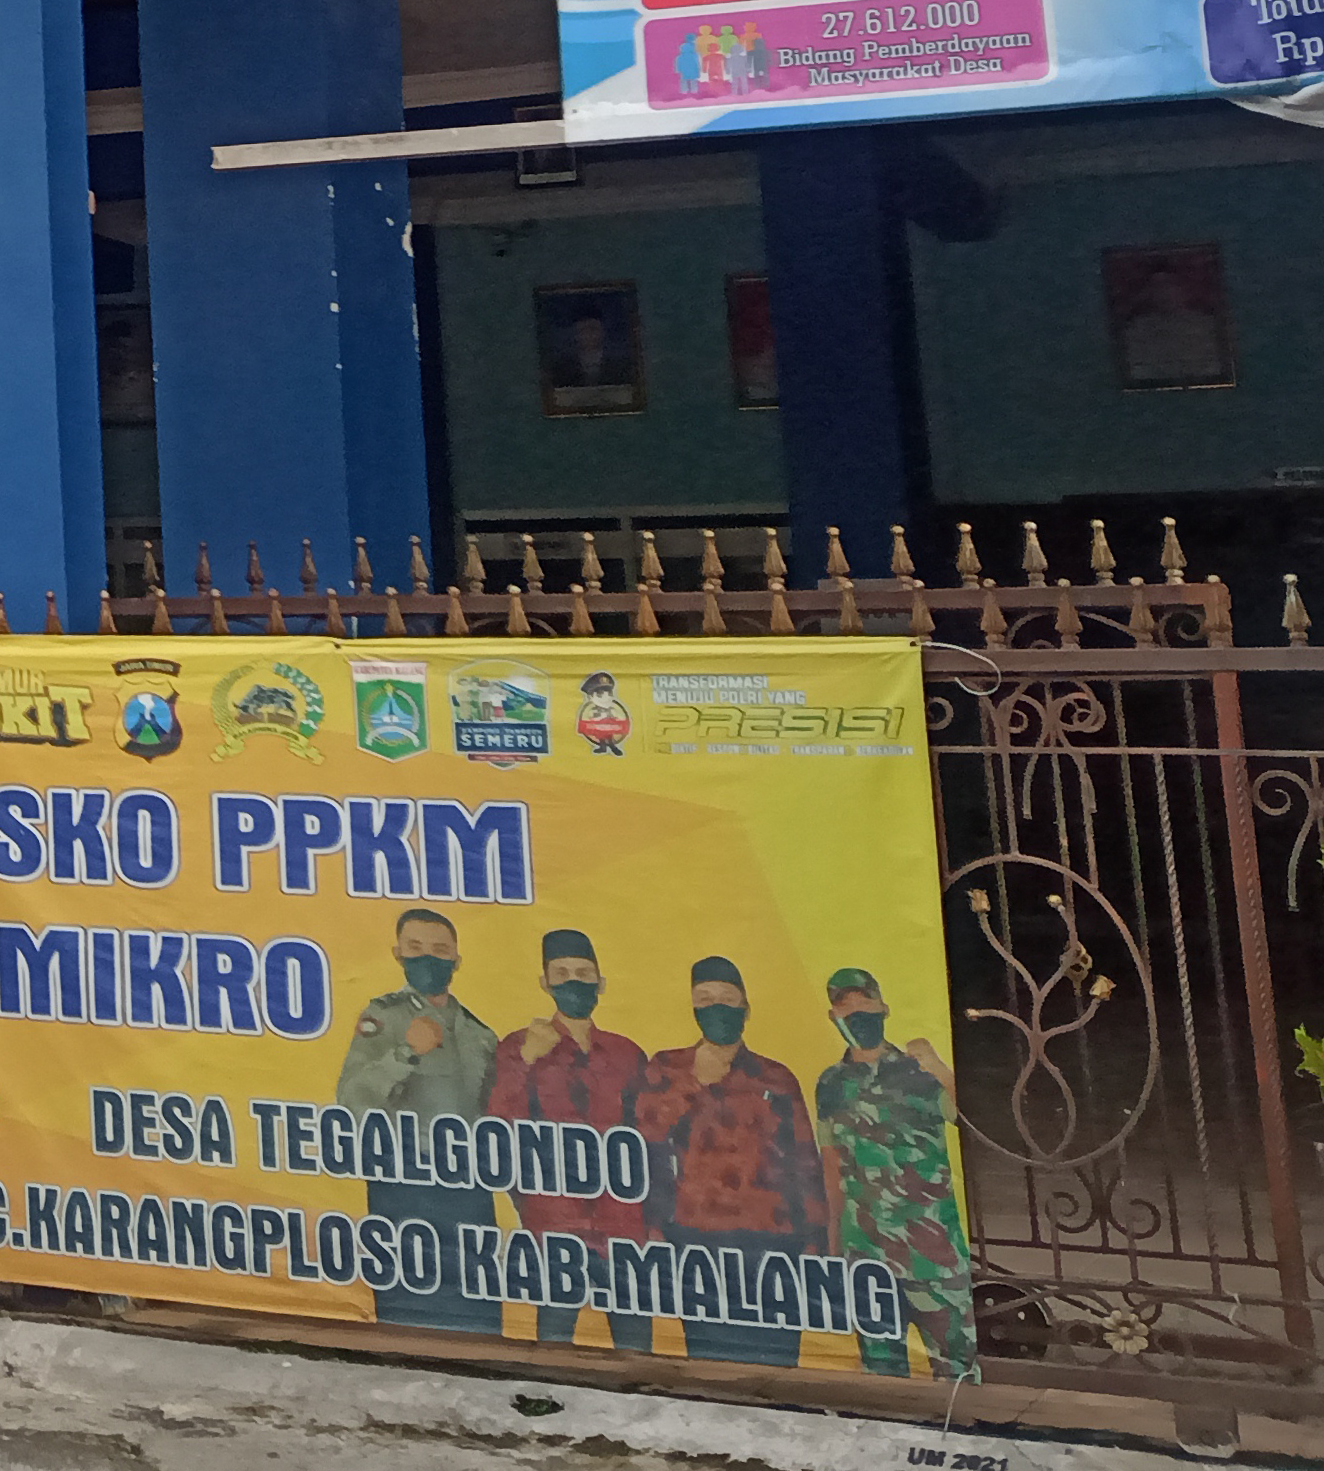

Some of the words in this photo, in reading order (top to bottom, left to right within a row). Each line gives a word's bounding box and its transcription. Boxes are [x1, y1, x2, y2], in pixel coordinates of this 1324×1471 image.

[821, 0, 980, 38] 27.612.000
[777, 47, 855, 68] Bidang
[862, 32, 1031, 61] Pemberdayaan
[809, 60, 941, 87] Masyarakat
[948, 57, 1002, 75] Desa
[652, 675, 769, 689] TRANSFORMASI
[653, 691, 714, 704] MENUJU
[719, 690, 762, 704] POLRI
[766, 691, 806, 704] YANG
[656, 706, 904, 740] PRESISI
[460, 734, 543, 748] SEMERU
[212, 792, 533, 904] PPKM
[90, 1086, 236, 1167] DESA
[249, 1099, 649, 1203] TEGALGONDO
[459, 1223, 902, 1340] KAB.MALANG
